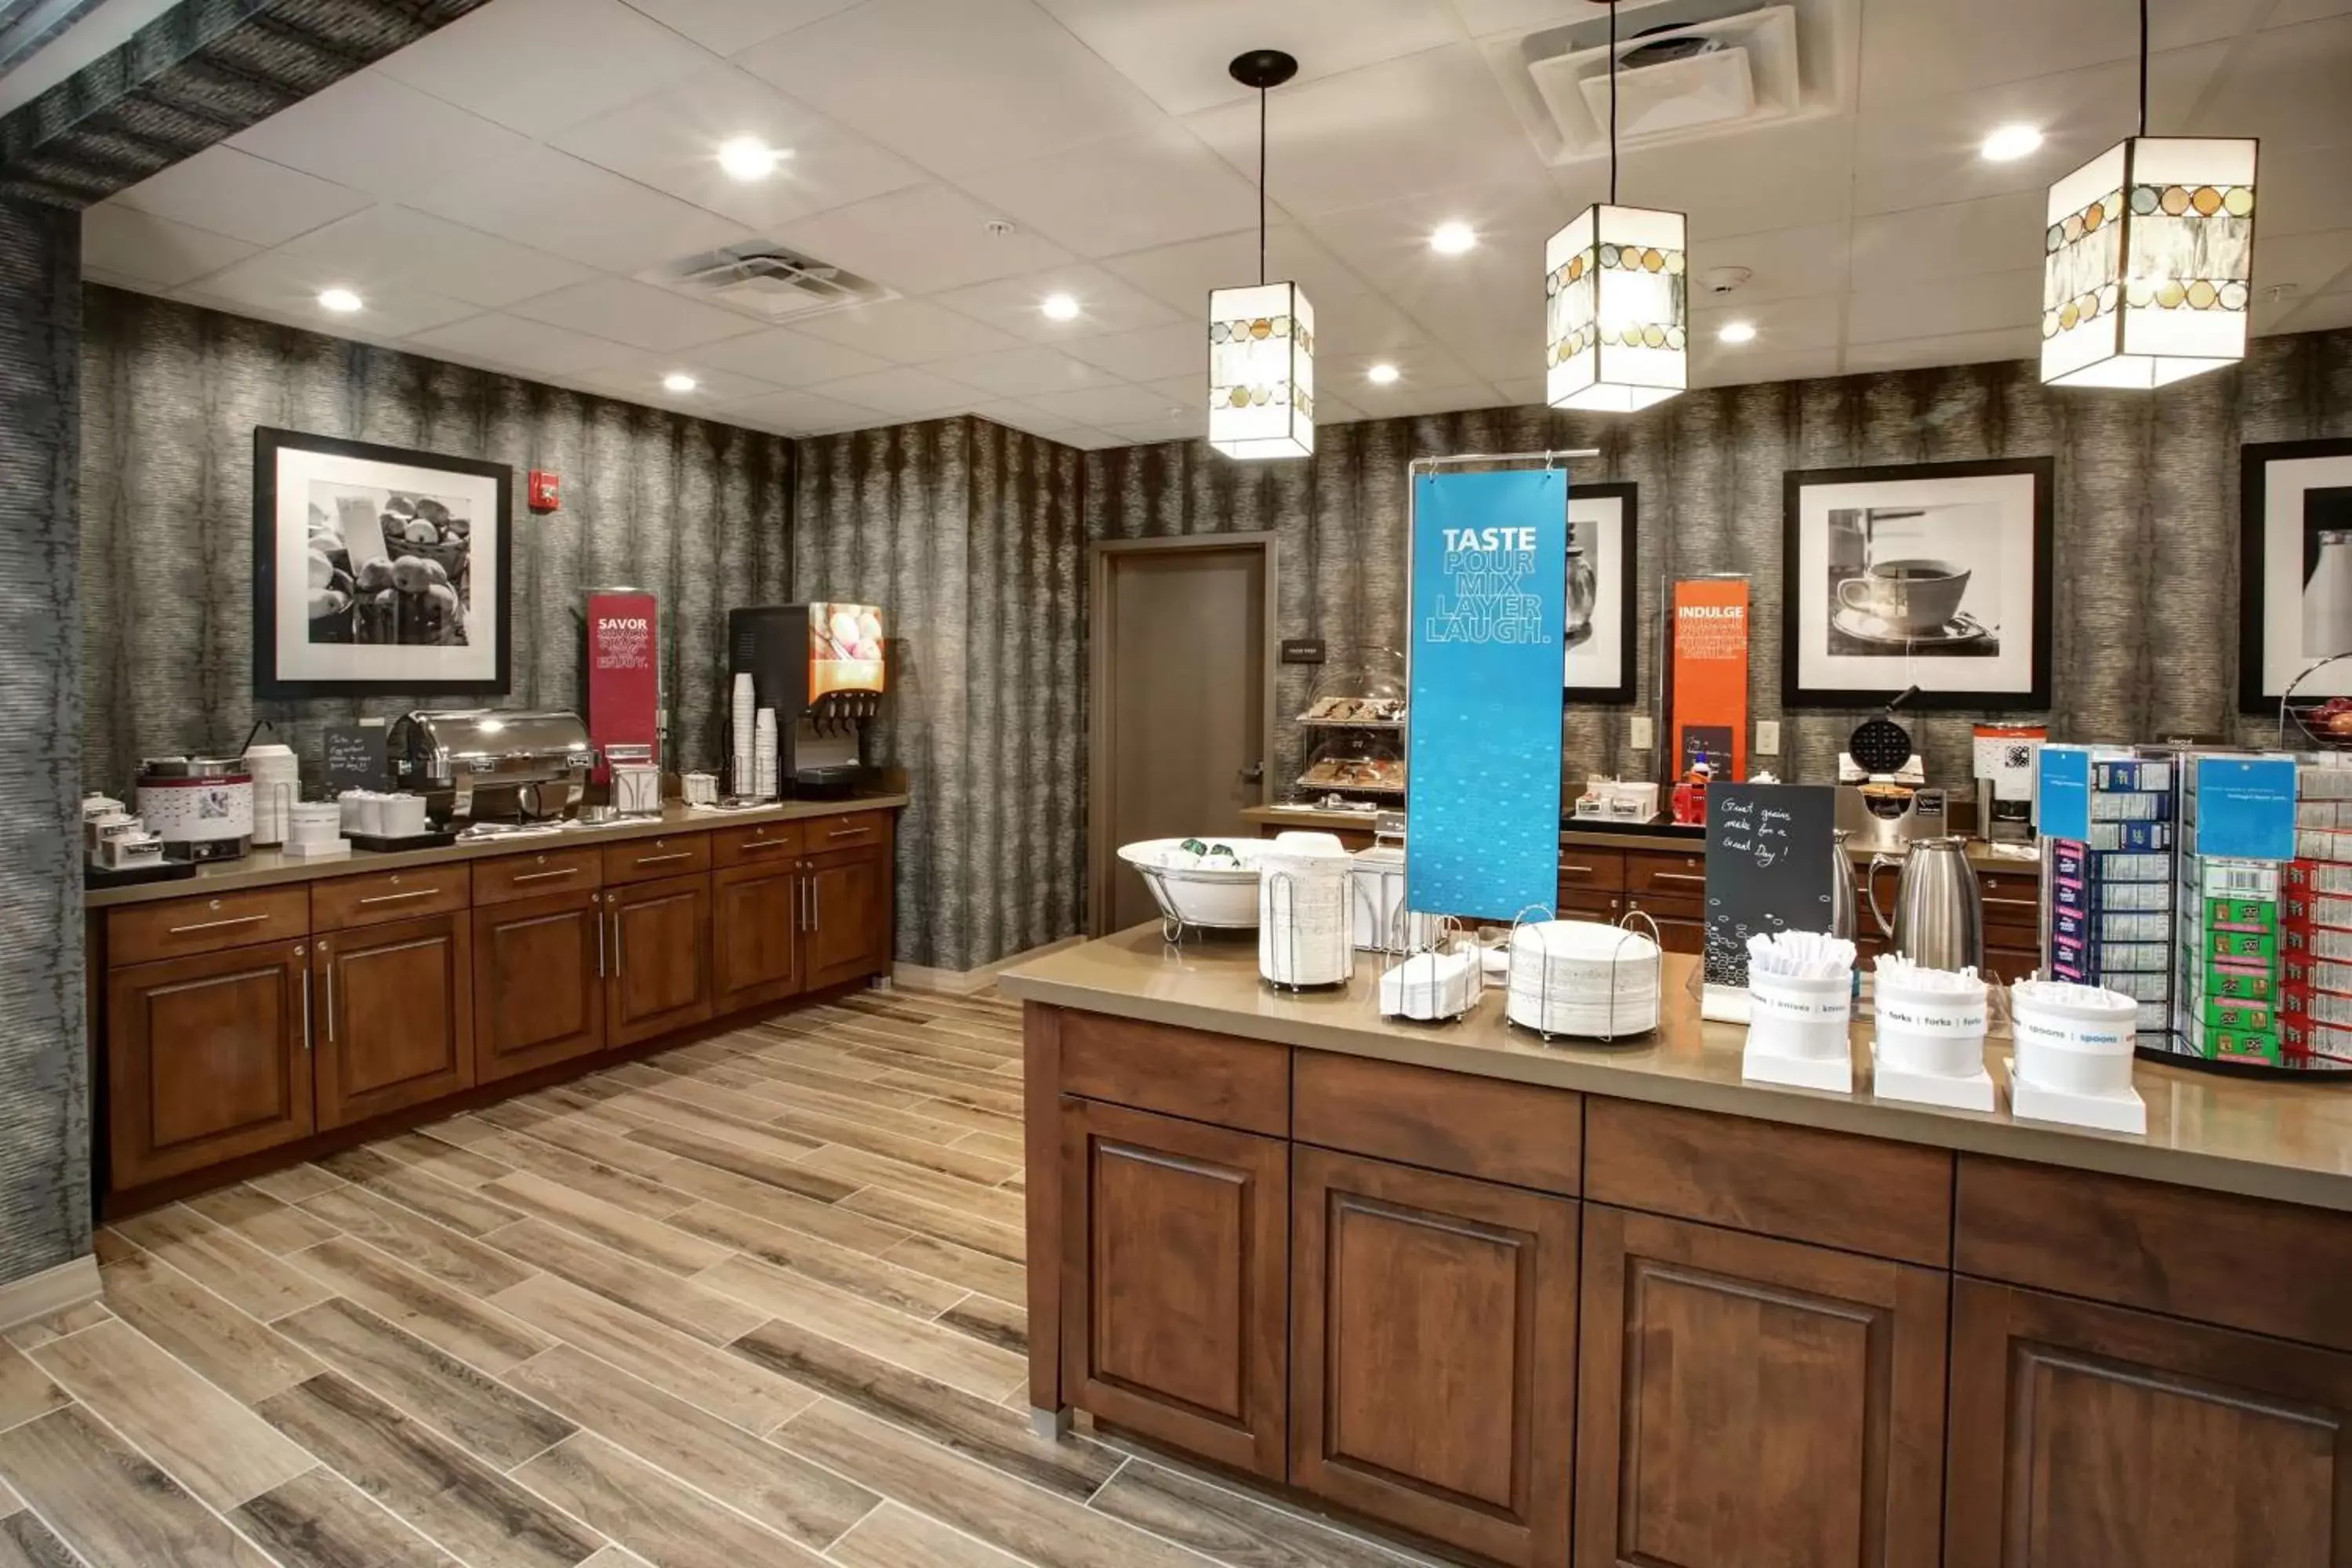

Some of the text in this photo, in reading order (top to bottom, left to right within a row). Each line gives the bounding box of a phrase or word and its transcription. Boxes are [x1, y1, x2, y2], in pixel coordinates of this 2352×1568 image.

[1443, 527, 1537, 551] TASTE
[1444, 549, 1535, 574] POUR
[1456, 572, 1523, 597] MIX
[1436, 593, 1542, 620] LAYER
[1679, 606, 1744, 619] INDULGE
[598, 619, 648, 630] SAVOR
[1426, 618, 1552, 644] LAUGH.
[1889, 1011, 1912, 1022] forks
[1924, 1017, 1952, 1026] forks
[2029, 1024, 2066, 1039] spoons
[2080, 1033, 2118, 1044] spoons
